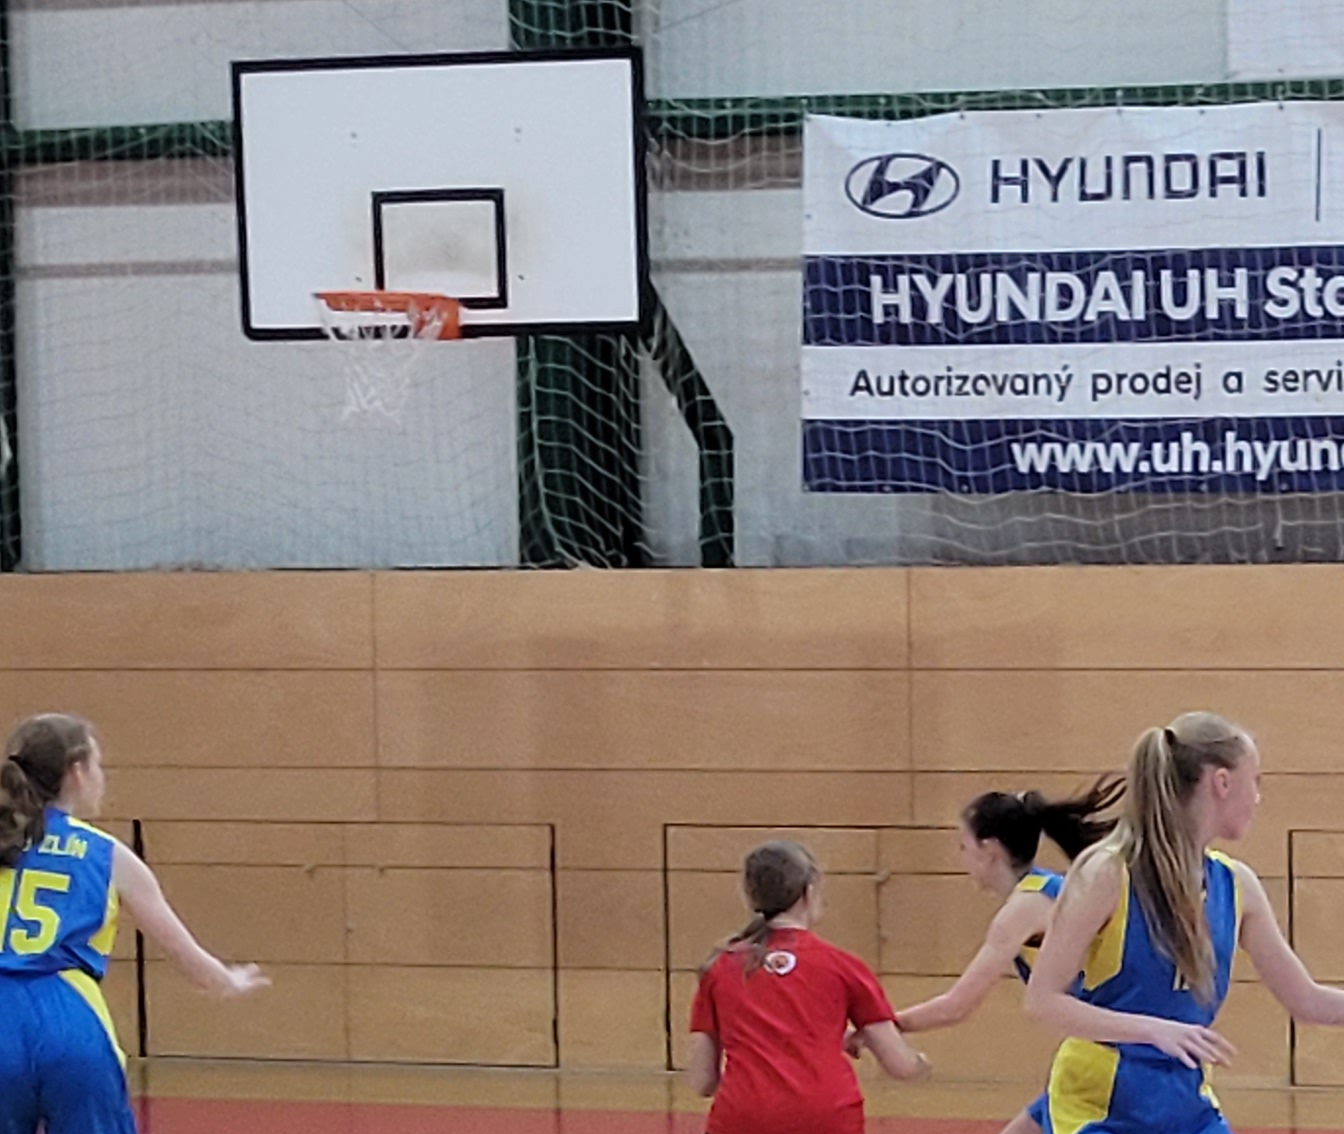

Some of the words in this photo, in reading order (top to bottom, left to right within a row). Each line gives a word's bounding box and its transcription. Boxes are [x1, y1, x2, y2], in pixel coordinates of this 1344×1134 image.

[991, 151, 1267, 205] HYUNDAI
[870, 268, 1146, 326] HYUNDAI
[1160, 267, 1247, 321] UH
[849, 359, 1073, 404] Autorizovaný
[1090, 360, 1203, 402] prodej
[1222, 370, 1244, 395] a
